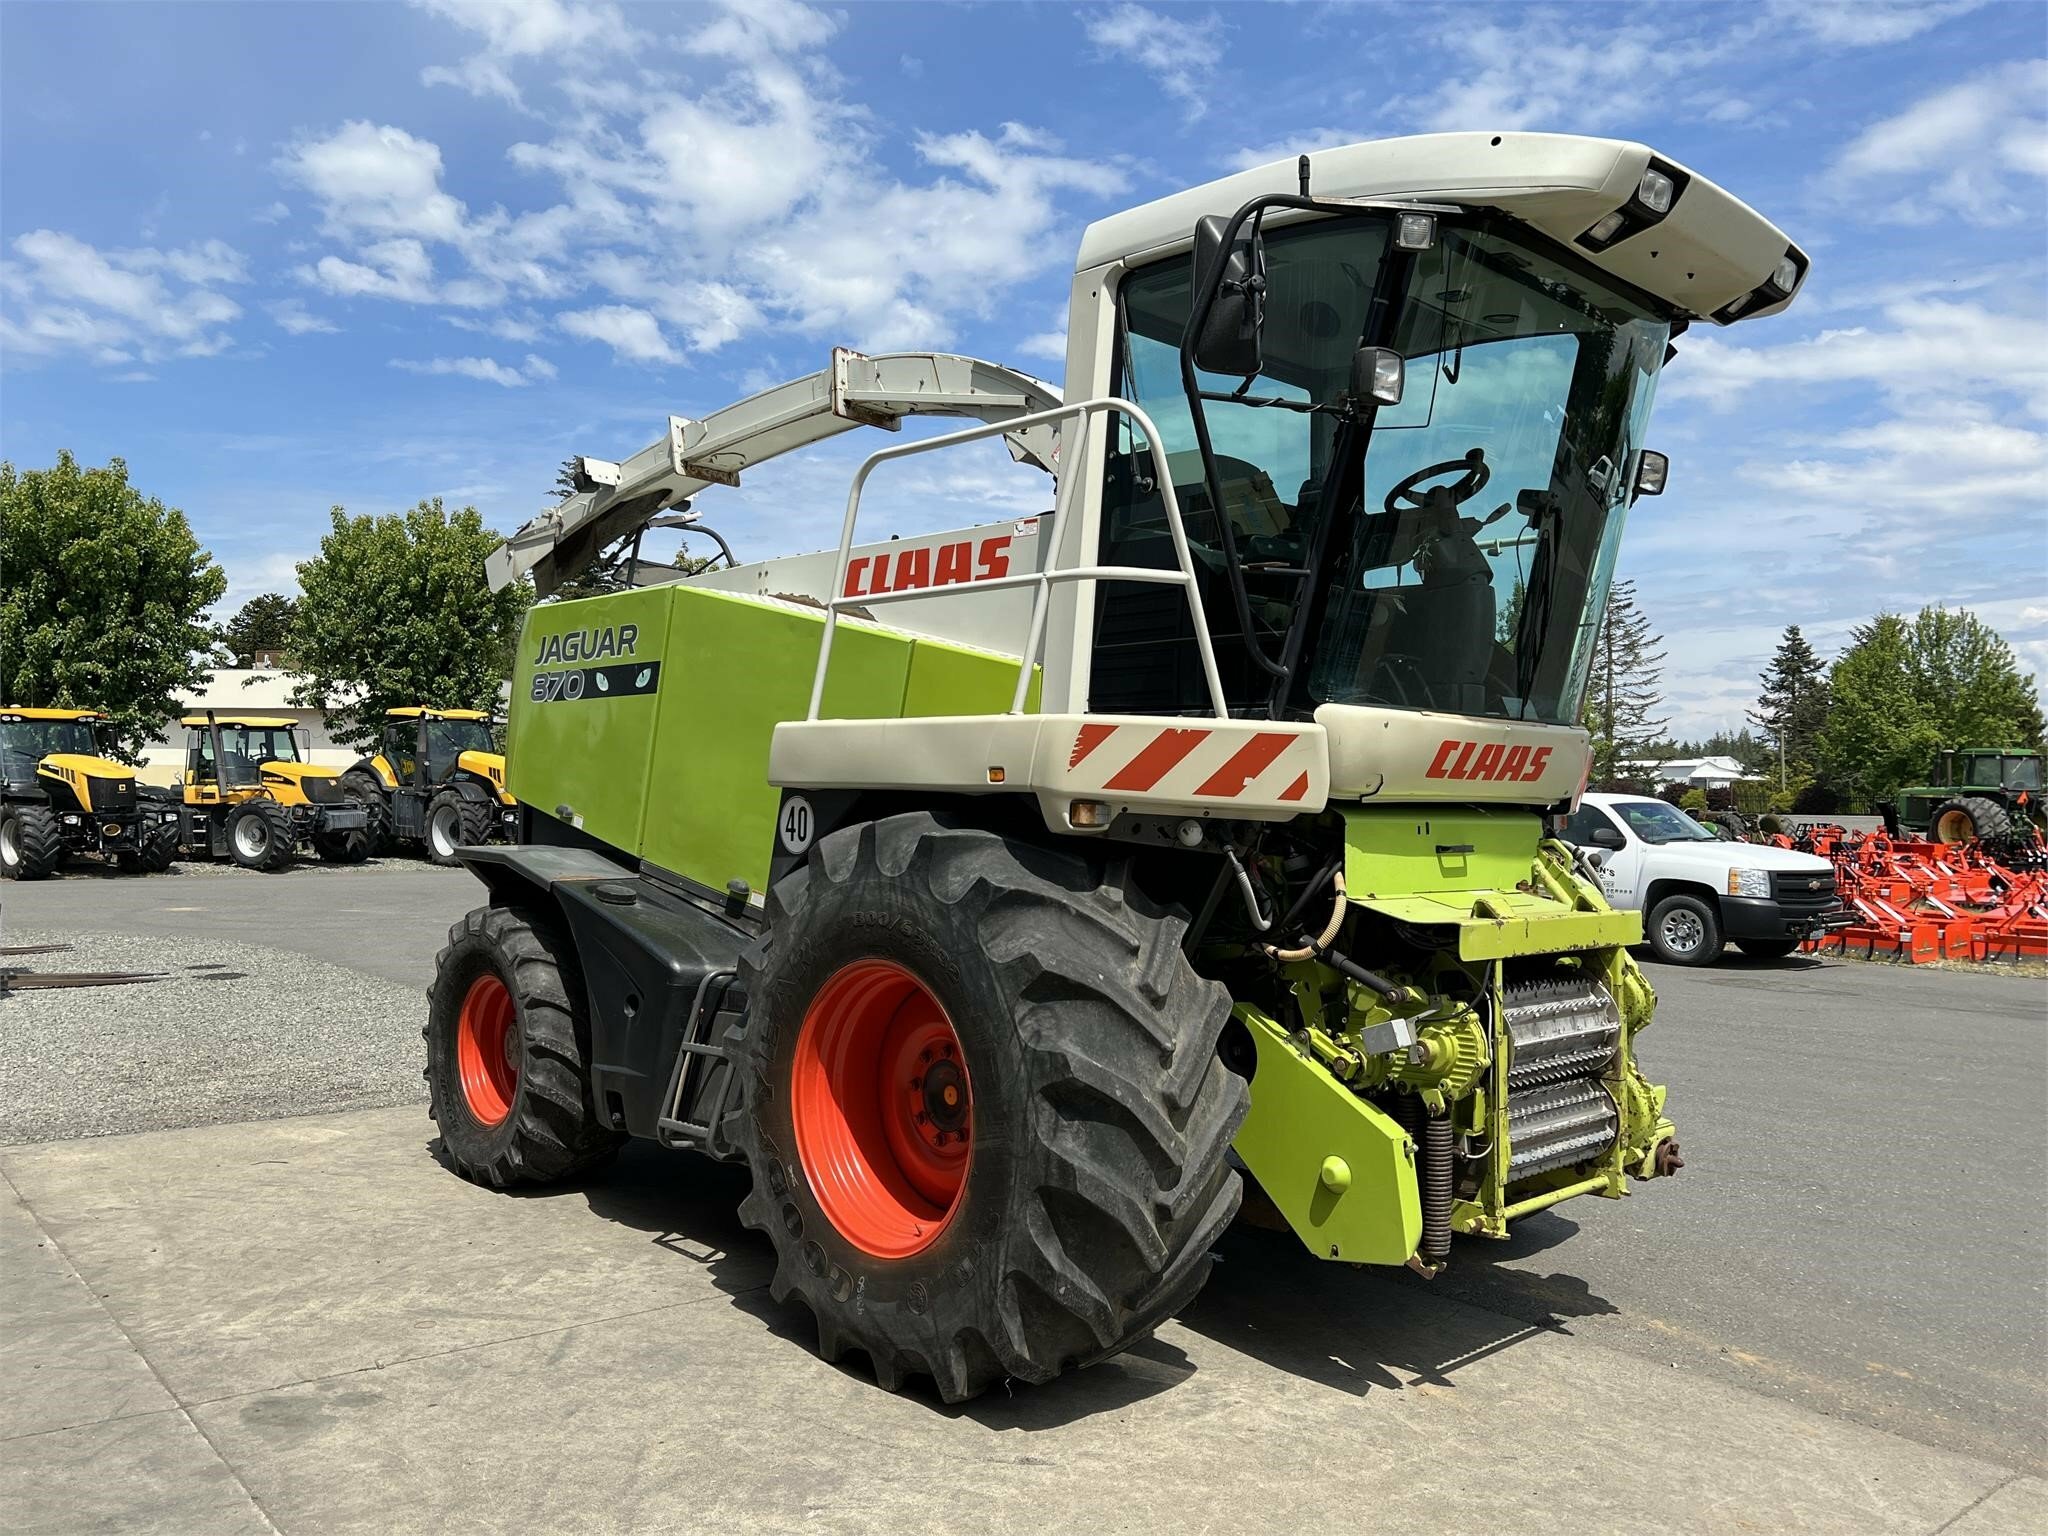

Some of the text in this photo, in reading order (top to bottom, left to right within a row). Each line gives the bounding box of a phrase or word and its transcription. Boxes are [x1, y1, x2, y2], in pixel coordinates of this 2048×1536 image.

[844, 536, 1011, 597] CLAAS
[535, 624, 638, 666] JAGUAR
[531, 669, 585, 703] 870
[1425, 740, 1553, 781] CLAAS
[785, 806, 807, 842] 40
